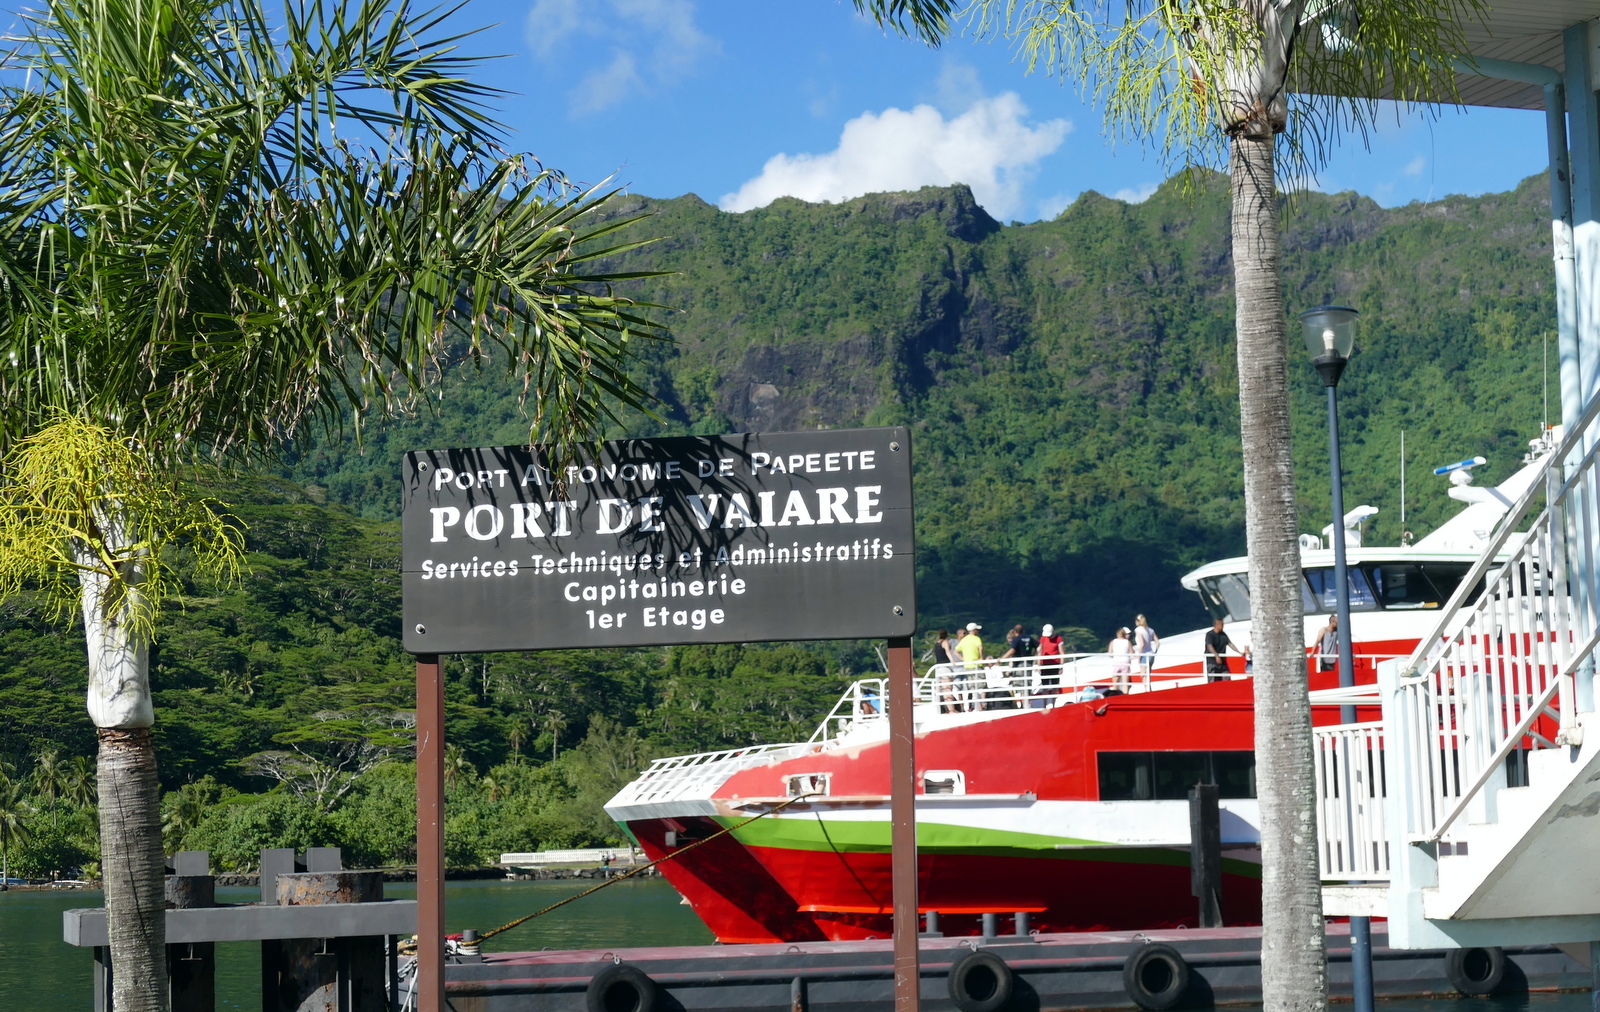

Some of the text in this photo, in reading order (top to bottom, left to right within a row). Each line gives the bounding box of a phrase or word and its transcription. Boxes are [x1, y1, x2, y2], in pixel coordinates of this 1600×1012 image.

[434, 467, 509, 491] PORT
[698, 458, 734, 478] DE
[751, 450, 876, 476] PAPEETE
[429, 485, 883, 543] PORT DE VAIARE
[421, 538, 893, 580] Services Techniques et Administratifs
[564, 574, 746, 606] Capitainerie
[586, 606, 725, 630] 1er Etage
